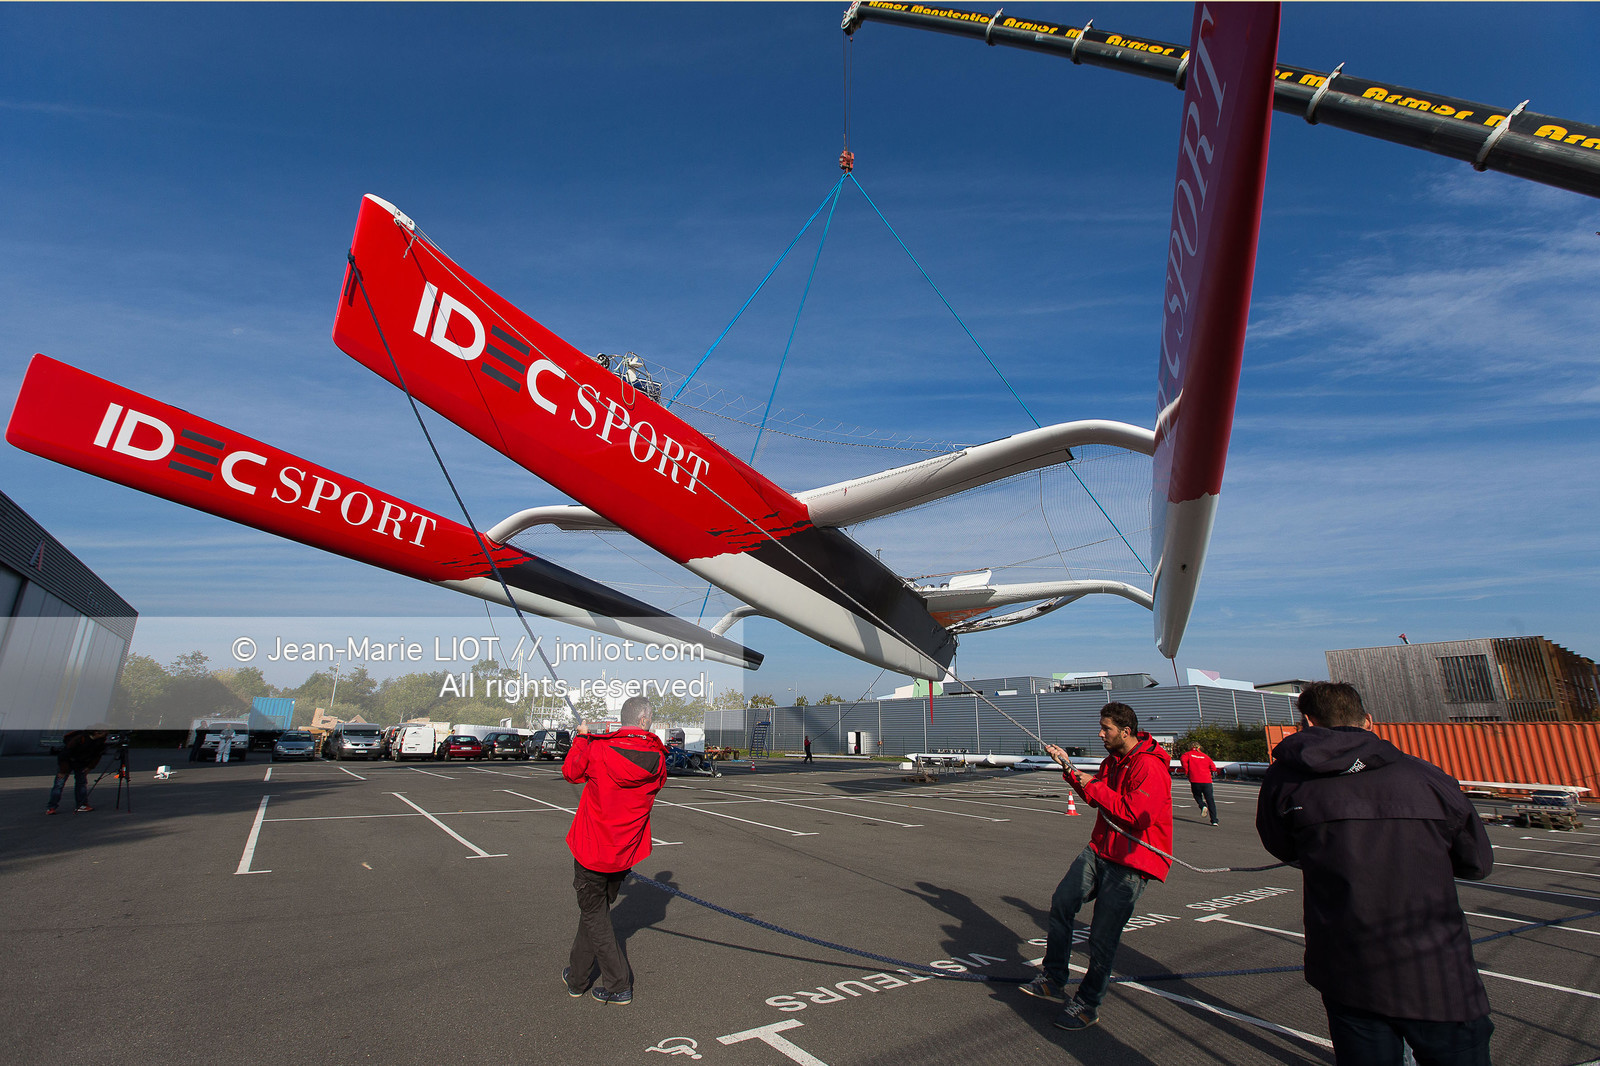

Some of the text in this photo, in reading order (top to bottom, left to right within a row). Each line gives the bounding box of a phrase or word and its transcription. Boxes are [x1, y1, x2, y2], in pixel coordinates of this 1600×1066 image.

[869, 1, 909, 11] Armor
[1361, 87, 1474, 120] Armor
[1165, 5, 1227, 342] SPORT
[413, 281, 710, 494] IDEC SPORT
[93, 402, 437, 548] IDEC SPORT
[1185, 886, 1295, 911] VISITEURS
